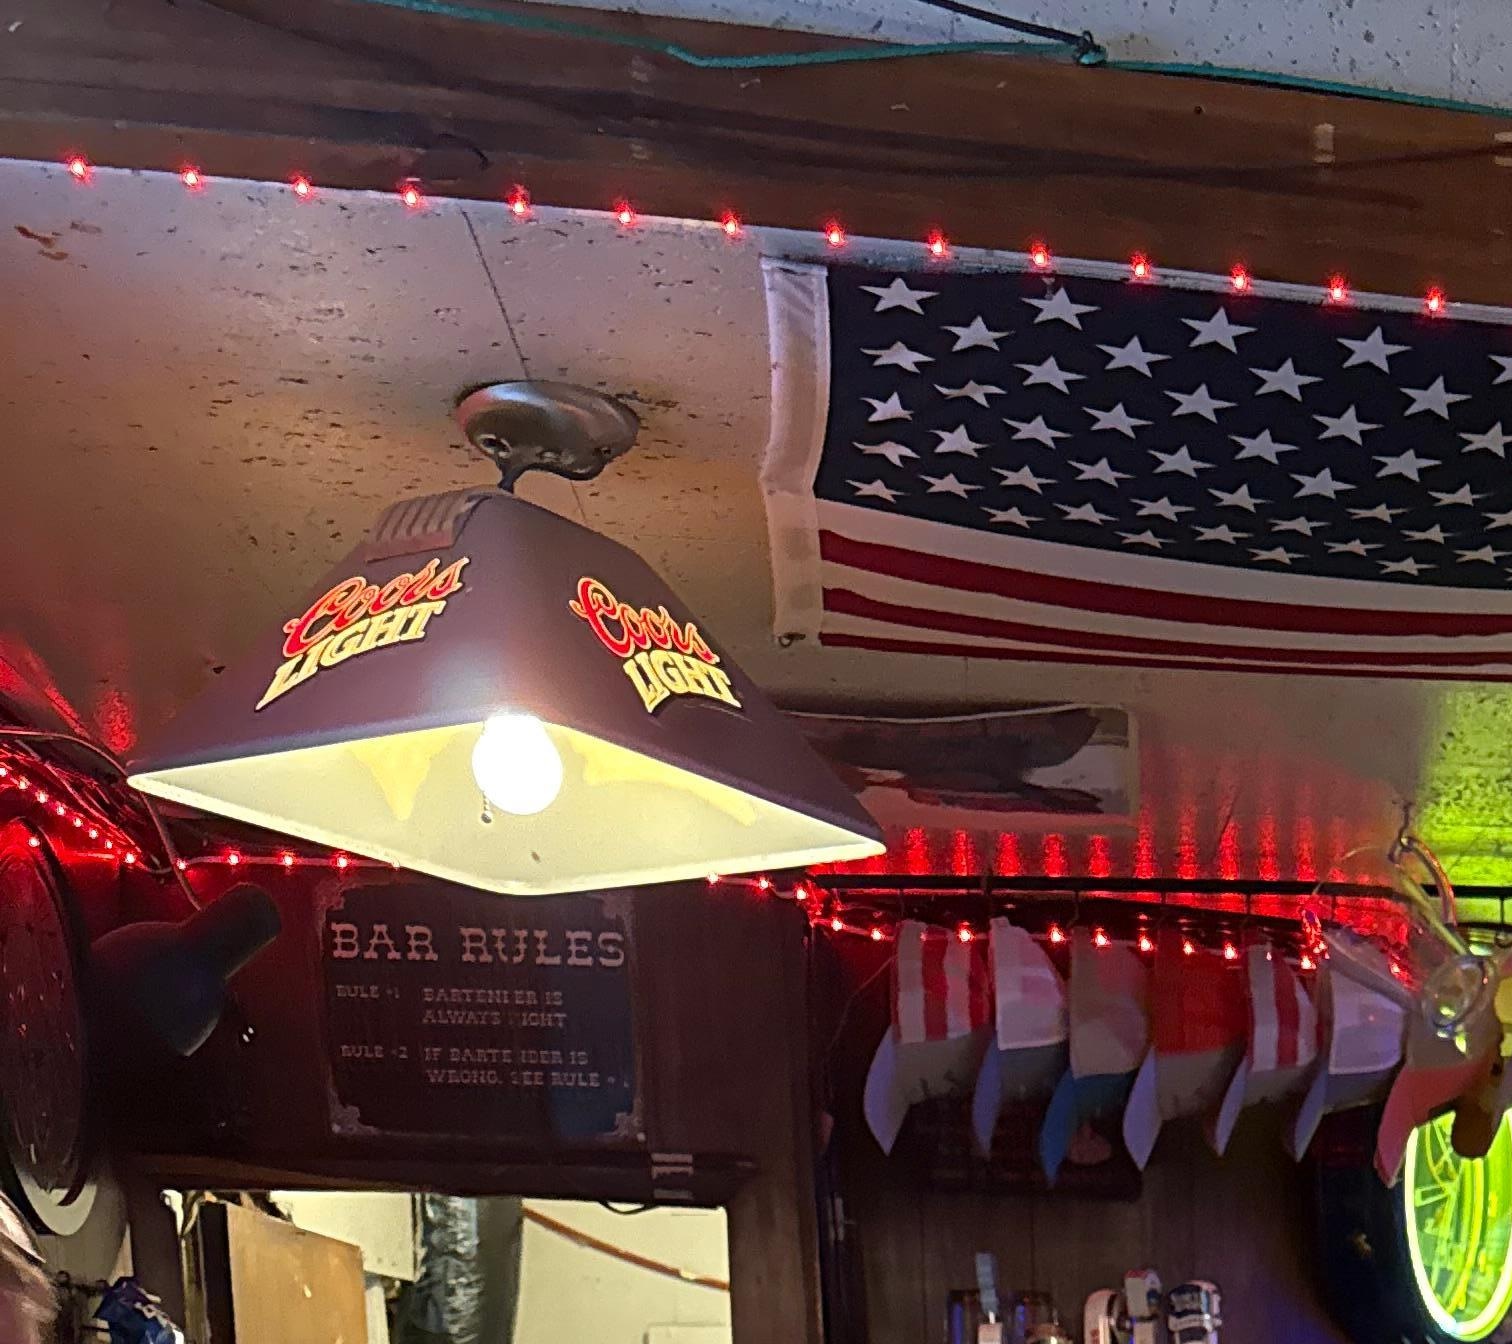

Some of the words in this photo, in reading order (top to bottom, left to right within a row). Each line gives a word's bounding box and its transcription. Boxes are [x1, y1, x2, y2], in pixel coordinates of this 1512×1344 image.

[283, 557, 470, 658] Coors
[569, 577, 721, 665] Coors
[255, 599, 446, 712] LIGHT
[624, 651, 742, 713] LIGHT
[330, 922, 439, 961] BAR
[458, 927, 626, 967] RULES
[508, 1013, 568, 1029] IGHT
[551, 1072, 600, 1088] RULE
